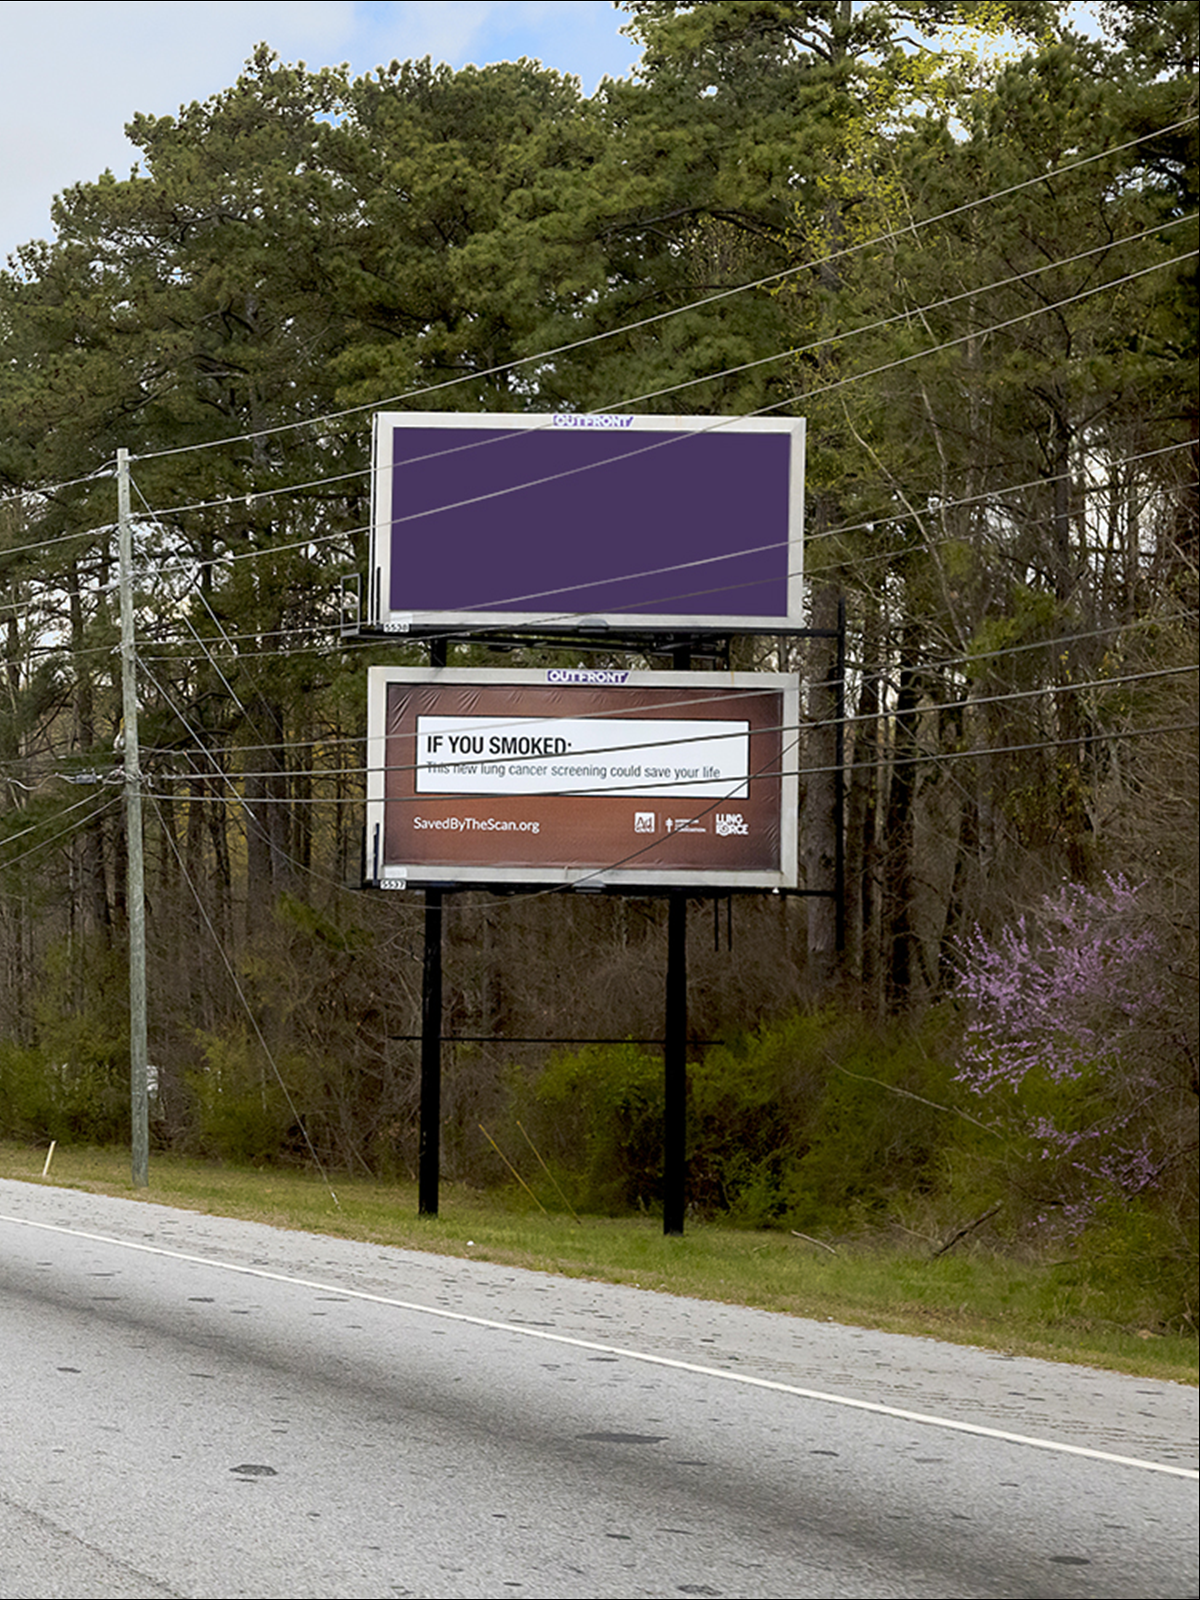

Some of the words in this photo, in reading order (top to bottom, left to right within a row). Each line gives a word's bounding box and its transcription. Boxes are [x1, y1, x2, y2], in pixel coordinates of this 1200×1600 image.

[554, 414, 632, 428] OUTFRONT
[548, 670, 627, 684] OUTFRONT
[427, 736, 443, 753] IF
[449, 736, 484, 754] YOU
[427, 761, 450, 774] This
[453, 763, 477, 774] new
[481, 763, 505, 777] lung
[509, 765, 547, 776] cancer
[551, 765, 607, 779] screening
[610, 766, 641, 777] could
[644, 769, 671, 778] save
[674, 769, 699, 780] your
[703, 767, 720, 778] life
[413, 816, 540, 834] SavedByTheScan.org
[716, 813, 743, 825] LUNG
